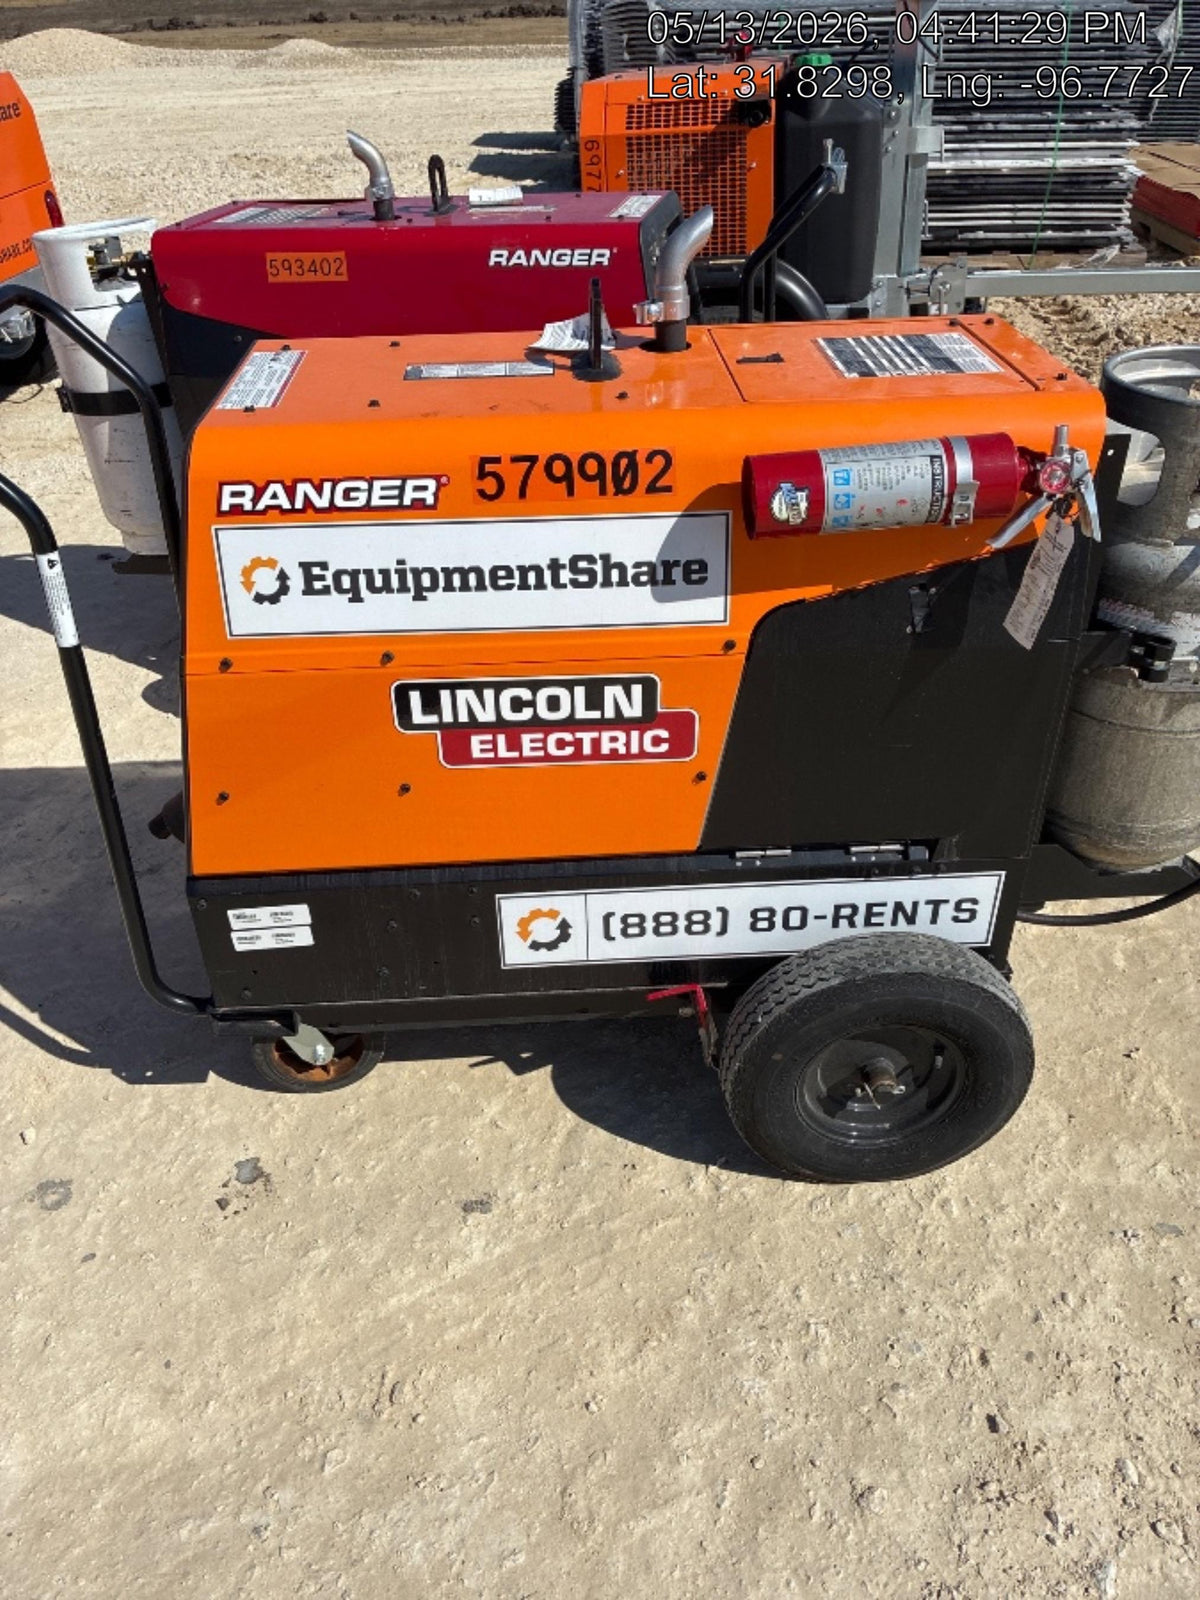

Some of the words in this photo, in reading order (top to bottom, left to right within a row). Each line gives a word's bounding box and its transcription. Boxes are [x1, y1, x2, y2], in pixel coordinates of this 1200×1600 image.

[0, 102, 21, 121] are
[268, 256, 345, 277] 593402
[488, 248, 611, 267] RANGER
[476, 448, 674, 502] 579902
[298, 552, 709, 604] EquipmentShare
[407, 682, 644, 725] LINCOLN
[470, 727, 671, 759] ELECTRIC
[602, 905, 731, 942] (888)
[749, 896, 979, 932] 80-RENTS
